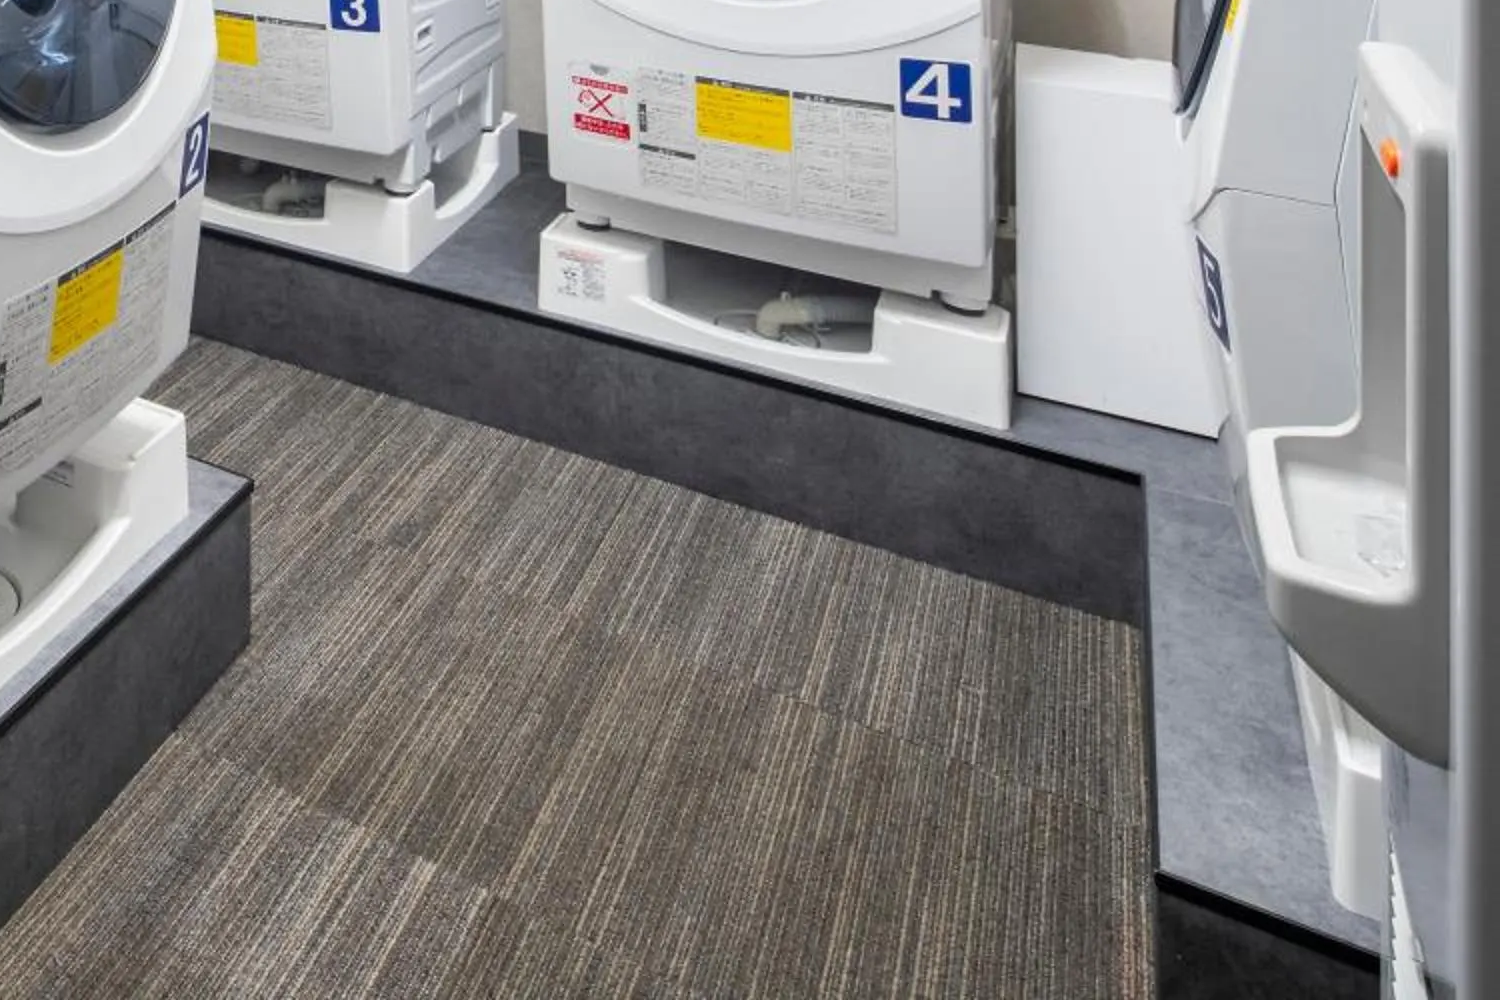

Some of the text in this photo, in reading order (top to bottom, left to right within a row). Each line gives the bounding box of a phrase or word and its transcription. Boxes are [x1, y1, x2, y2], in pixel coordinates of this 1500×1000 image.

[905, 63, 961, 119] 4
[185, 124, 204, 190] 2
[1202, 251, 1223, 329] 5
